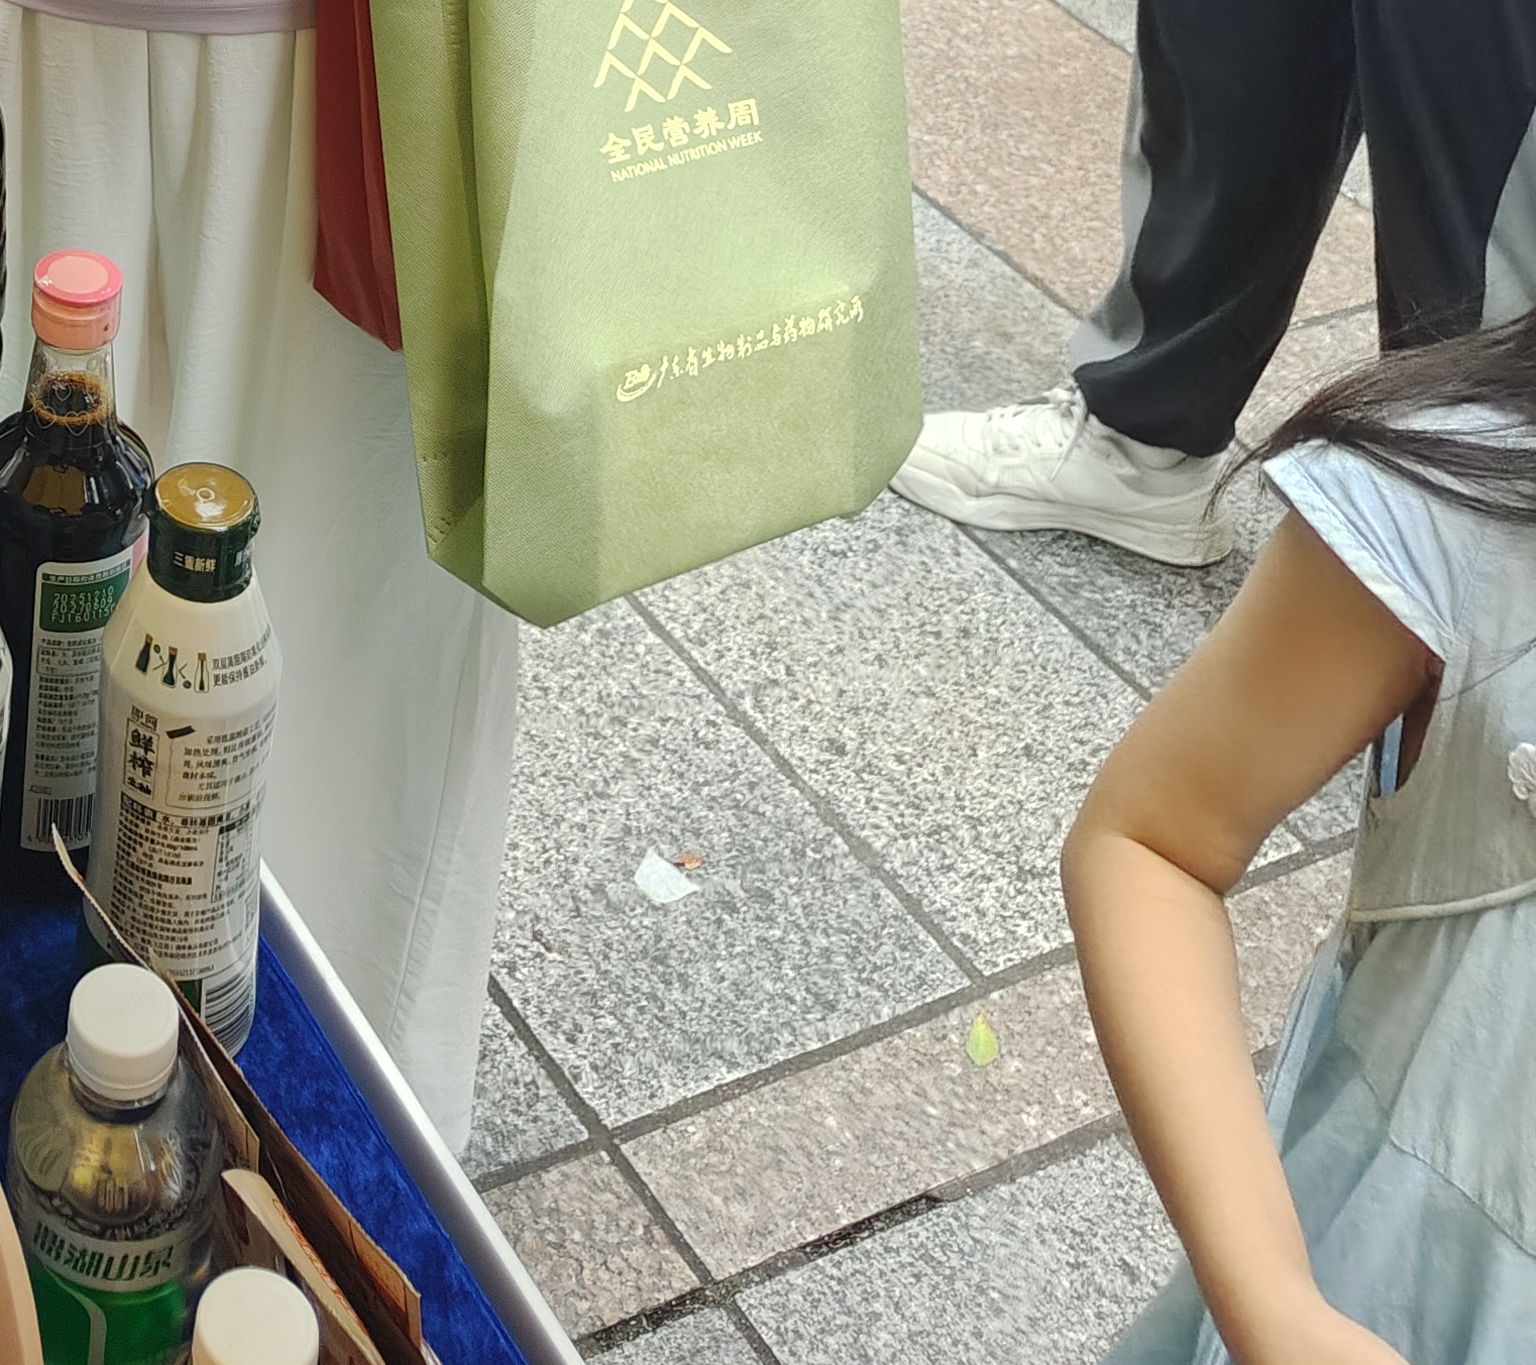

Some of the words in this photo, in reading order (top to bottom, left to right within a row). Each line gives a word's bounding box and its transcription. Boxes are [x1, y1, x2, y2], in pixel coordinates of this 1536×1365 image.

[599, 98, 761, 166] 全民营养周
[610, 156, 667, 183] NATIONAL
[667, 140, 728, 169] NUTRITION
[727, 130, 764, 154] WEEK
[172, 549, 218, 574] 三重新鲜
